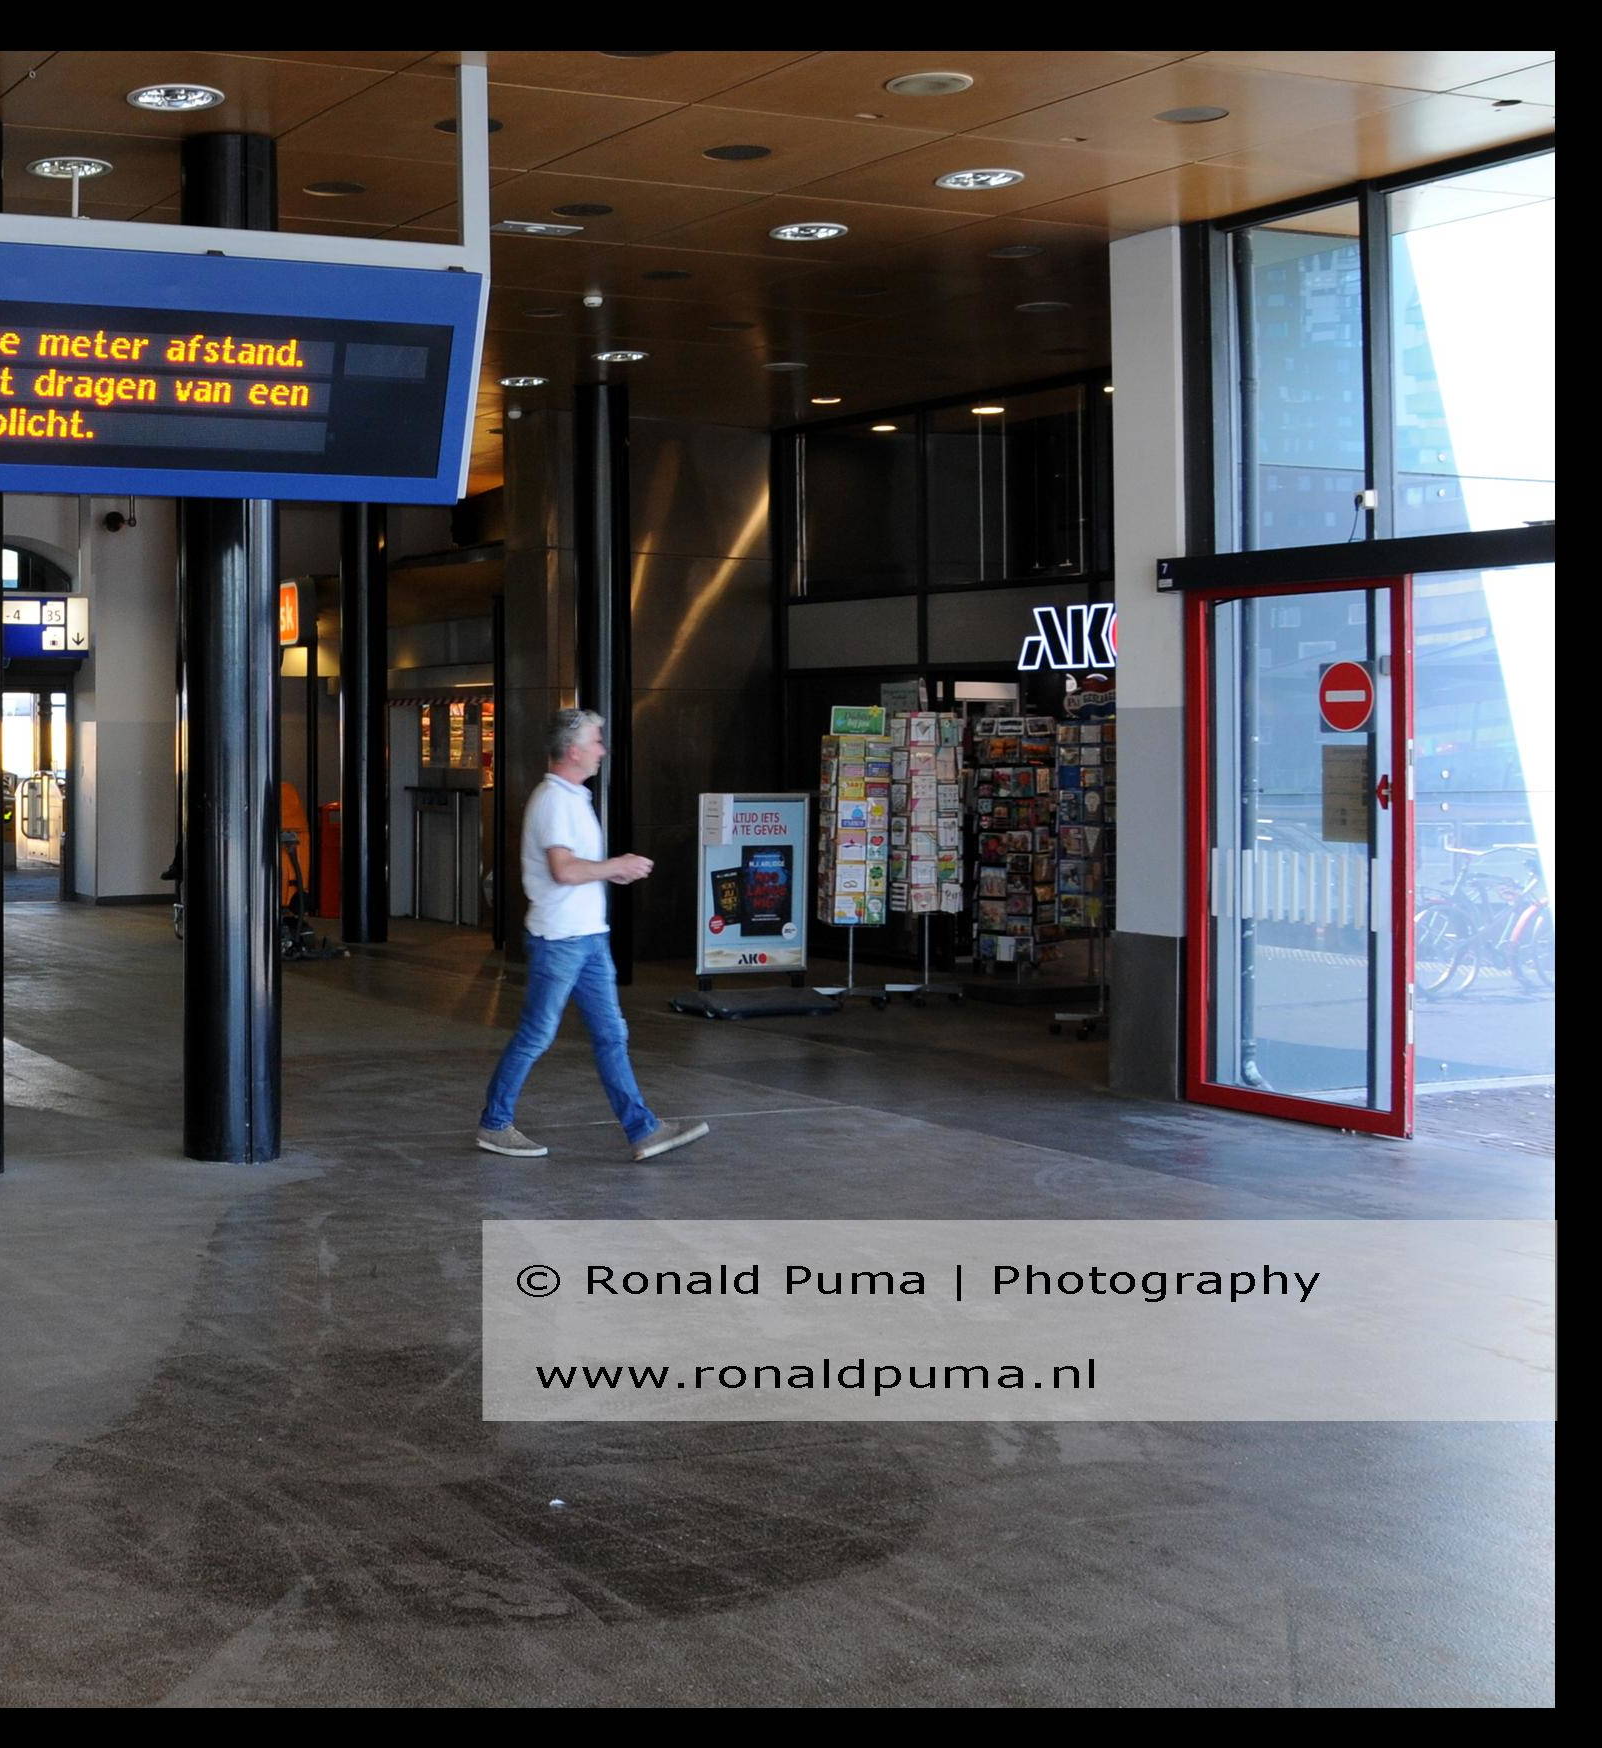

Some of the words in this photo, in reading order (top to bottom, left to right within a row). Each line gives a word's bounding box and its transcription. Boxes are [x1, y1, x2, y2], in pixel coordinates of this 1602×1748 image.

[37, 329, 149, 361] meter
[164, 334, 304, 368] afstand.
[32, 368, 158, 407] dragen
[173, 379, 232, 405] van
[248, 382, 310, 408] een
[1161, 562, 1168, 575] 7
[1017, 602, 1117, 671] AK
[761, 812, 780, 823] IETS
[742, 825, 750, 835] TE
[754, 825, 787, 836] GEVEN
[738, 953, 768, 965] AKO
